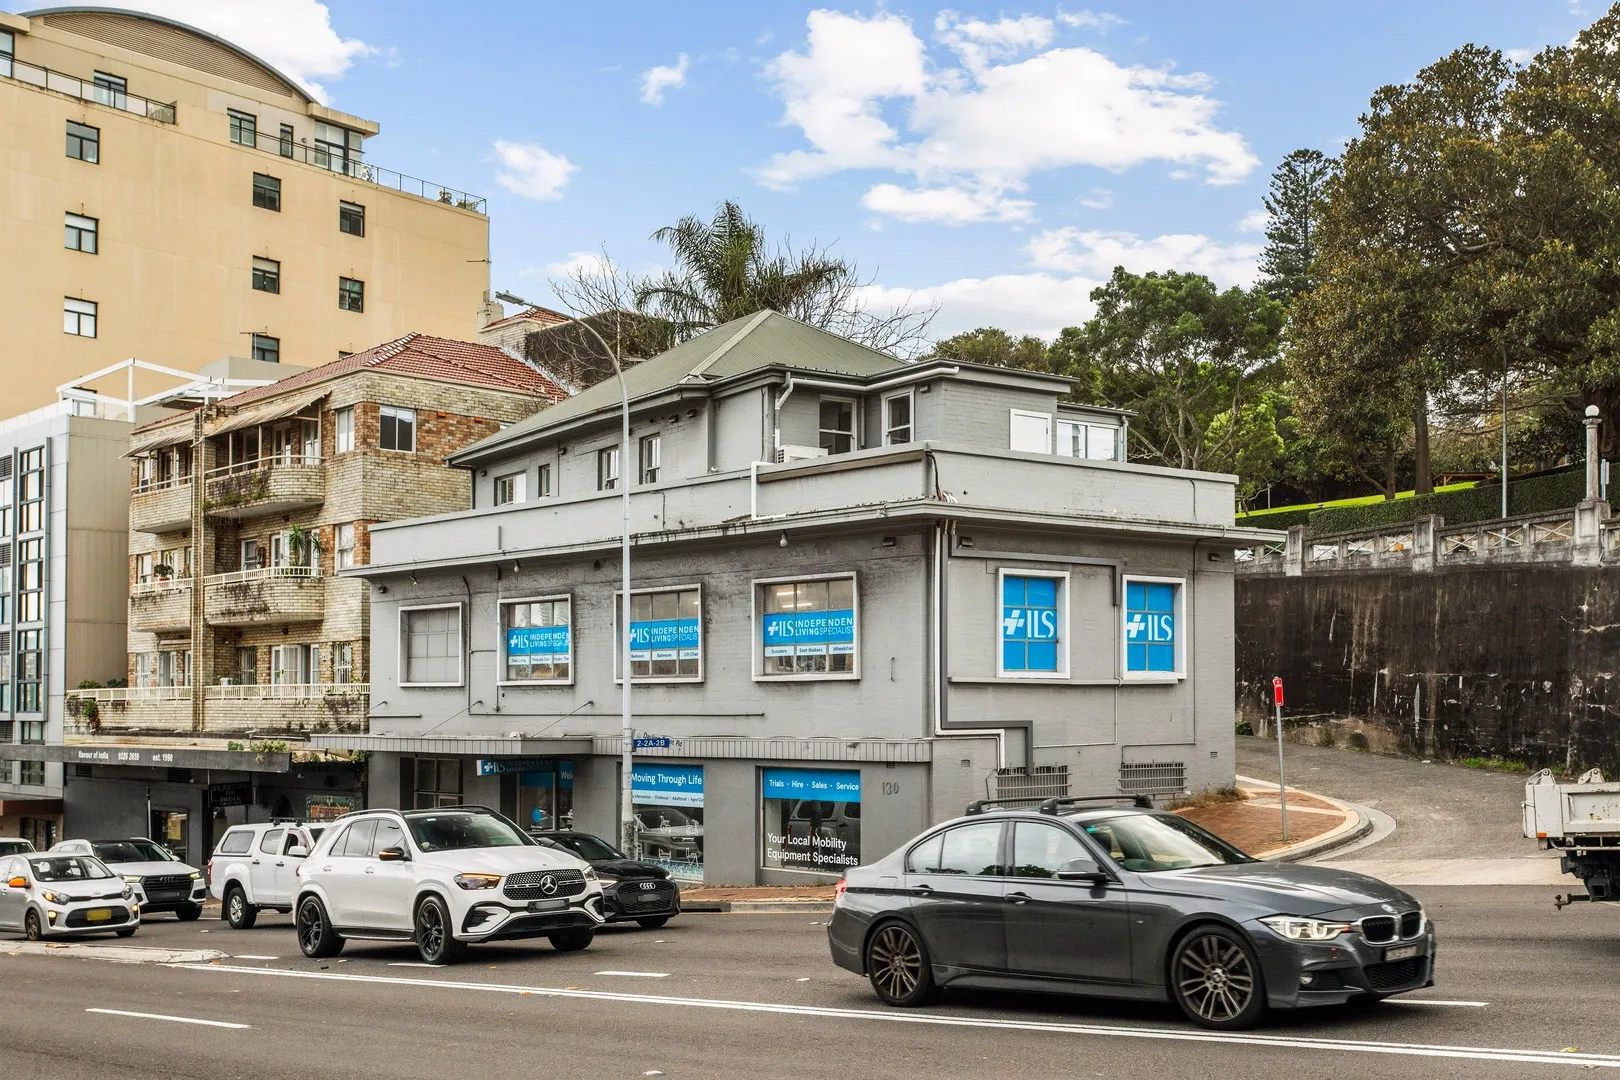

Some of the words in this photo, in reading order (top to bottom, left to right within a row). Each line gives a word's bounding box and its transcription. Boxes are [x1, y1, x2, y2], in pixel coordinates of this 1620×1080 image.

[779, 620, 794, 637] ILS
[1027, 610, 1055, 638] ILS
[1148, 614, 1172, 641] ILS
[518, 634, 529, 649] ILS
[637, 627, 650, 643] ILS
[493, 761, 506, 773] ILS
[631, 772, 656, 785] Moving
[657, 773, 687, 787] Through
[688, 774, 703, 785] Life
[769, 779, 785, 788] Trials
[791, 780, 805, 788] Hire
[811, 781, 828, 790] Sales
[836, 782, 860, 791] Service
[882, 782, 900, 795] 130
[767, 832, 786, 844] Your
[787, 834, 811, 846] Local
[812, 836, 847, 852] Mobility
[767, 848, 811, 863] Equipment
[812, 852, 859, 866] Specialists
